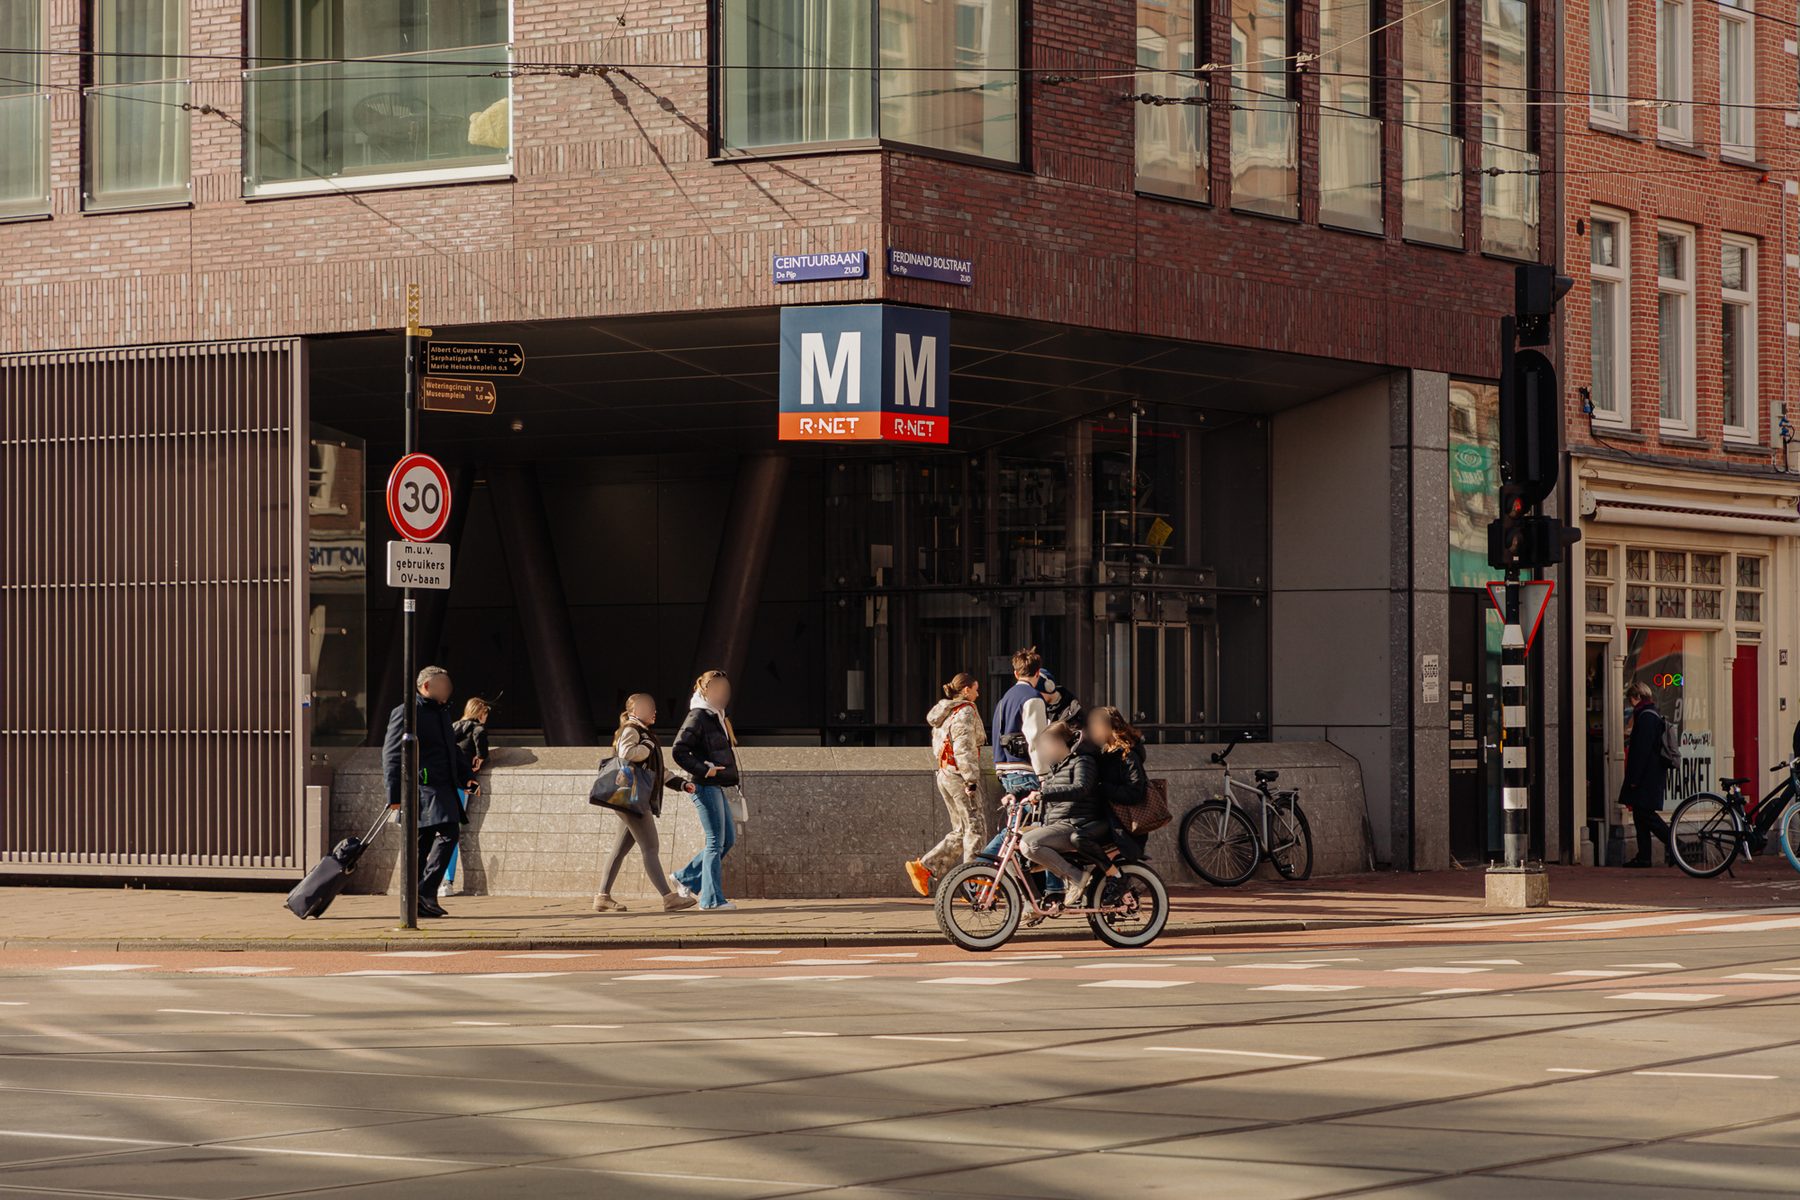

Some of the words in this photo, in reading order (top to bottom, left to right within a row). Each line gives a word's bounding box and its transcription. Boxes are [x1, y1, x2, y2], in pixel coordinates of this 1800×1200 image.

[775, 252, 860, 269] CEINTUURBAAN
[893, 251, 932, 267] FERDINAND
[933, 257, 972, 273] BOLSTRAAT
[776, 271, 785, 279] De
[786, 270, 797, 279] Pijp
[844, 266, 861, 274] ZUID
[960, 274, 972, 283] ZUID
[452, 347, 487, 355] Cuypmarkt
[431, 355, 472, 363] Sarphatipark
[450, 363, 497, 371] Heinekenplein
[800, 331, 861, 405] M
[894, 332, 937, 408] M
[426, 382, 472, 392] Weteringcircuit
[426, 391, 465, 399] Museumplein
[402, 481, 440, 514] 30
[405, 545, 433, 555] m.u.v.
[396, 559, 445, 571] gebruikers
[400, 573, 440, 585] OV-baan
